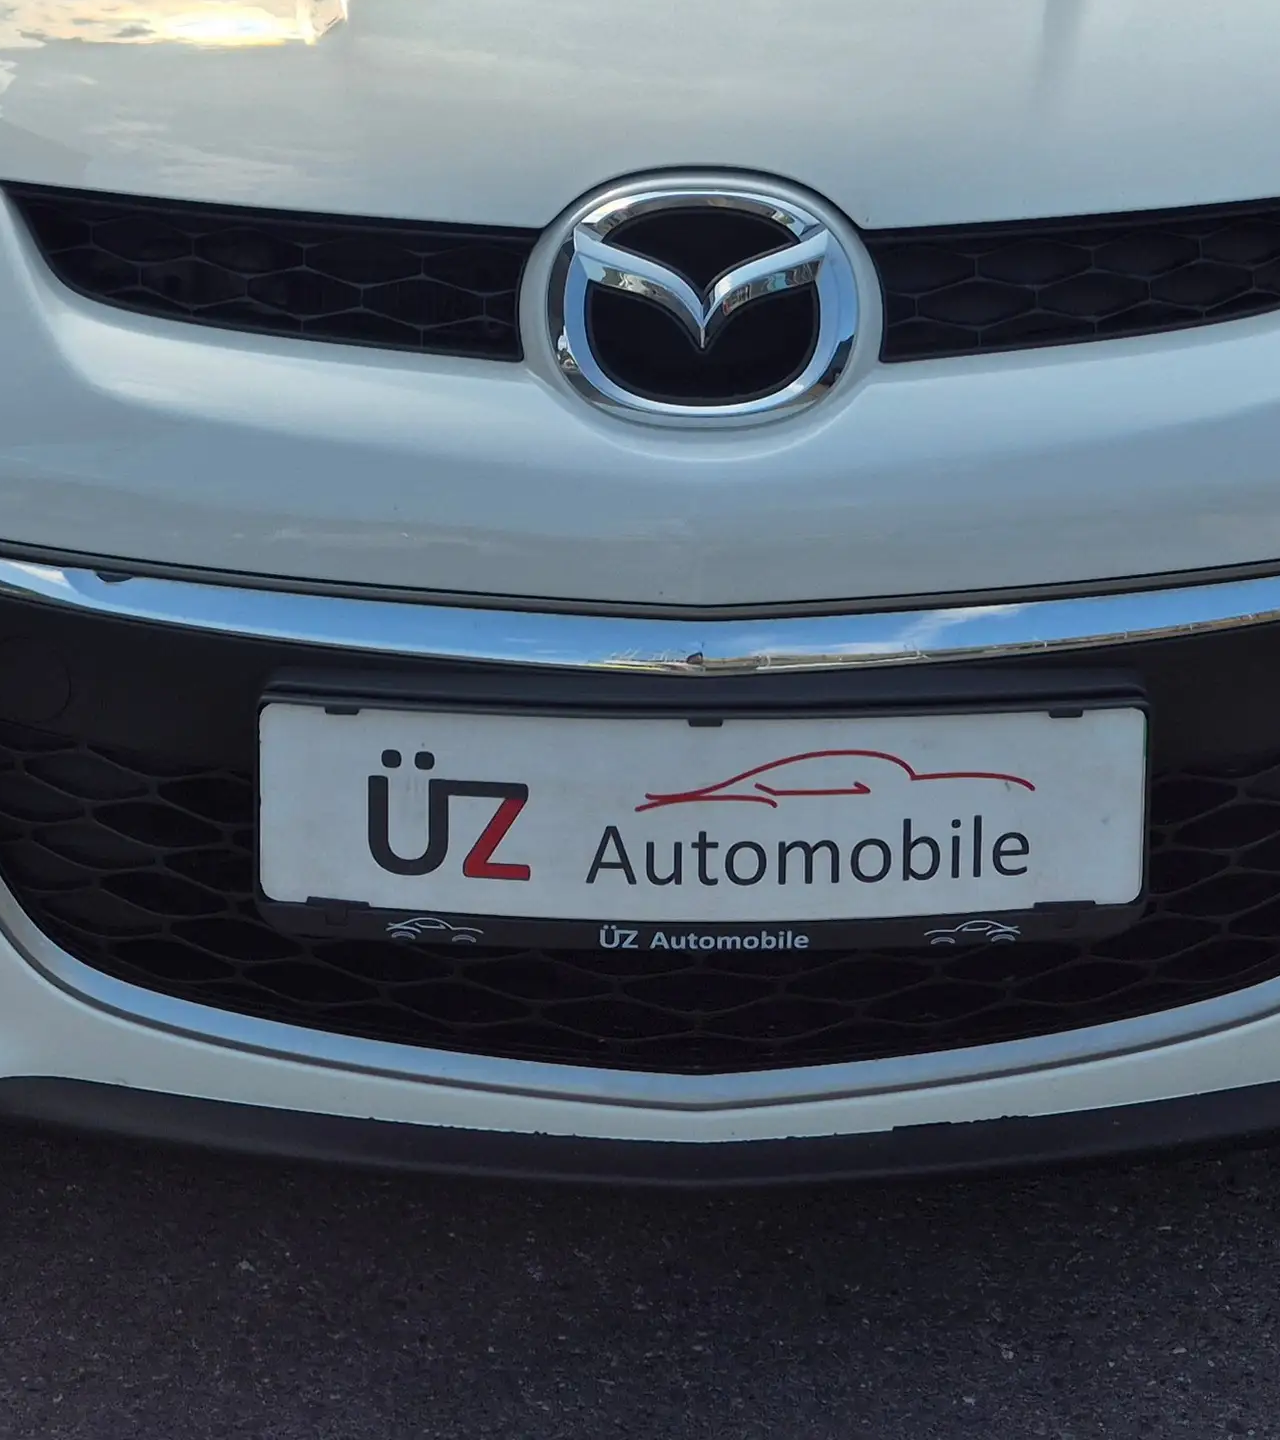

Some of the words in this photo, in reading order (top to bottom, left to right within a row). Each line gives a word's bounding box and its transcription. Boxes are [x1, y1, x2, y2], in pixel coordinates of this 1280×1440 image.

[367, 748, 531, 882] ÜZ
[586, 815, 1031, 888] Automobile
[599, 924, 639, 950] ÜZ
[650, 928, 810, 951] Automobile
